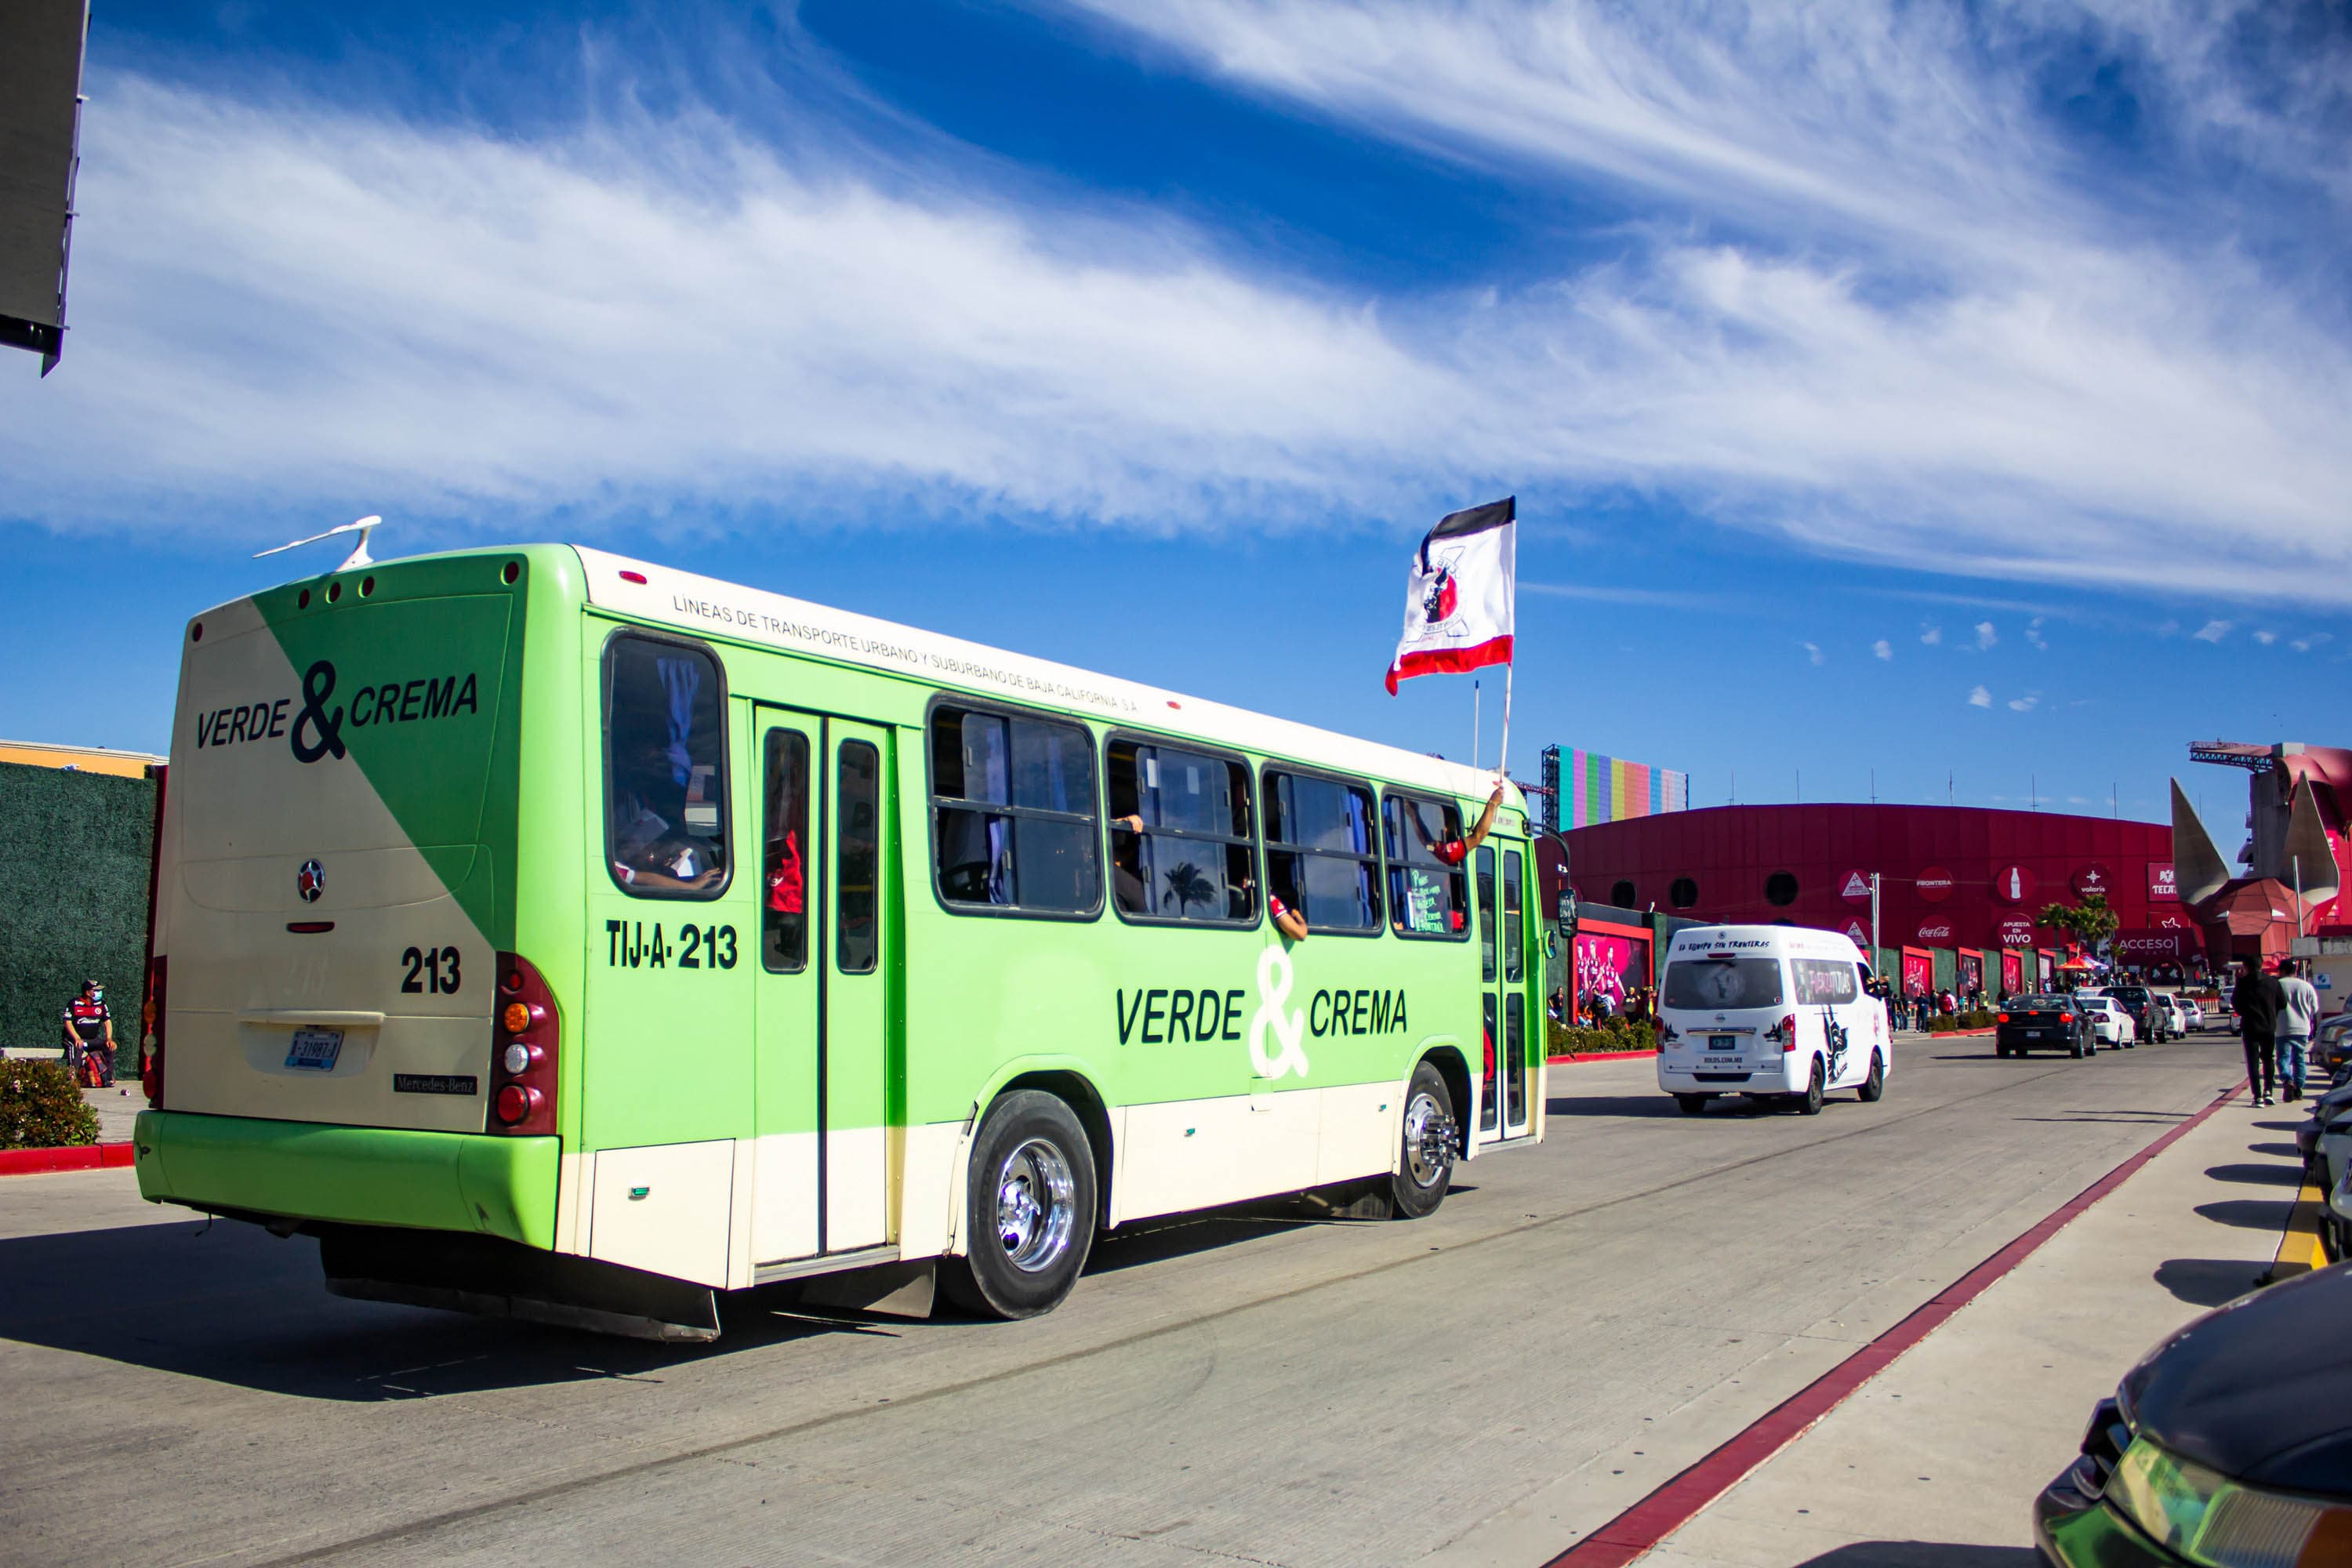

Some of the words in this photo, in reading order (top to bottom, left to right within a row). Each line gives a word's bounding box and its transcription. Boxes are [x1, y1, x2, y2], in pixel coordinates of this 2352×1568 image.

[736, 610, 758, 629] DE
[760, 615, 859, 652] TRANSPORTE
[861, 639, 918, 664] URBANO
[920, 652, 927, 666] Y
[931, 654, 1007, 684] SUBURBANO
[1008, 673, 1025, 688] DE
[1026, 677, 1055, 695] BAJA
[1056, 684, 1118, 709] CALIFORNIA
[196, 698, 291, 750] VERDE
[290, 659, 347, 764] &
[349, 673, 477, 728] CREMA
[1688, 942, 1711, 952] EQUIPO
[1714, 941, 1726, 949] SIN
[1728, 940, 1770, 949] FRONTERAS
[2002, 934, 2031, 943] VIVO
[2118, 938, 2174, 949] ACCESO
[401, 946, 462, 995] 213
[1116, 988, 1246, 1046] VERDE
[1249, 944, 1309, 1080] &
[1309, 988, 1407, 1037] CREMA
[397, 1076, 474, 1093] Mercedes-Benz
